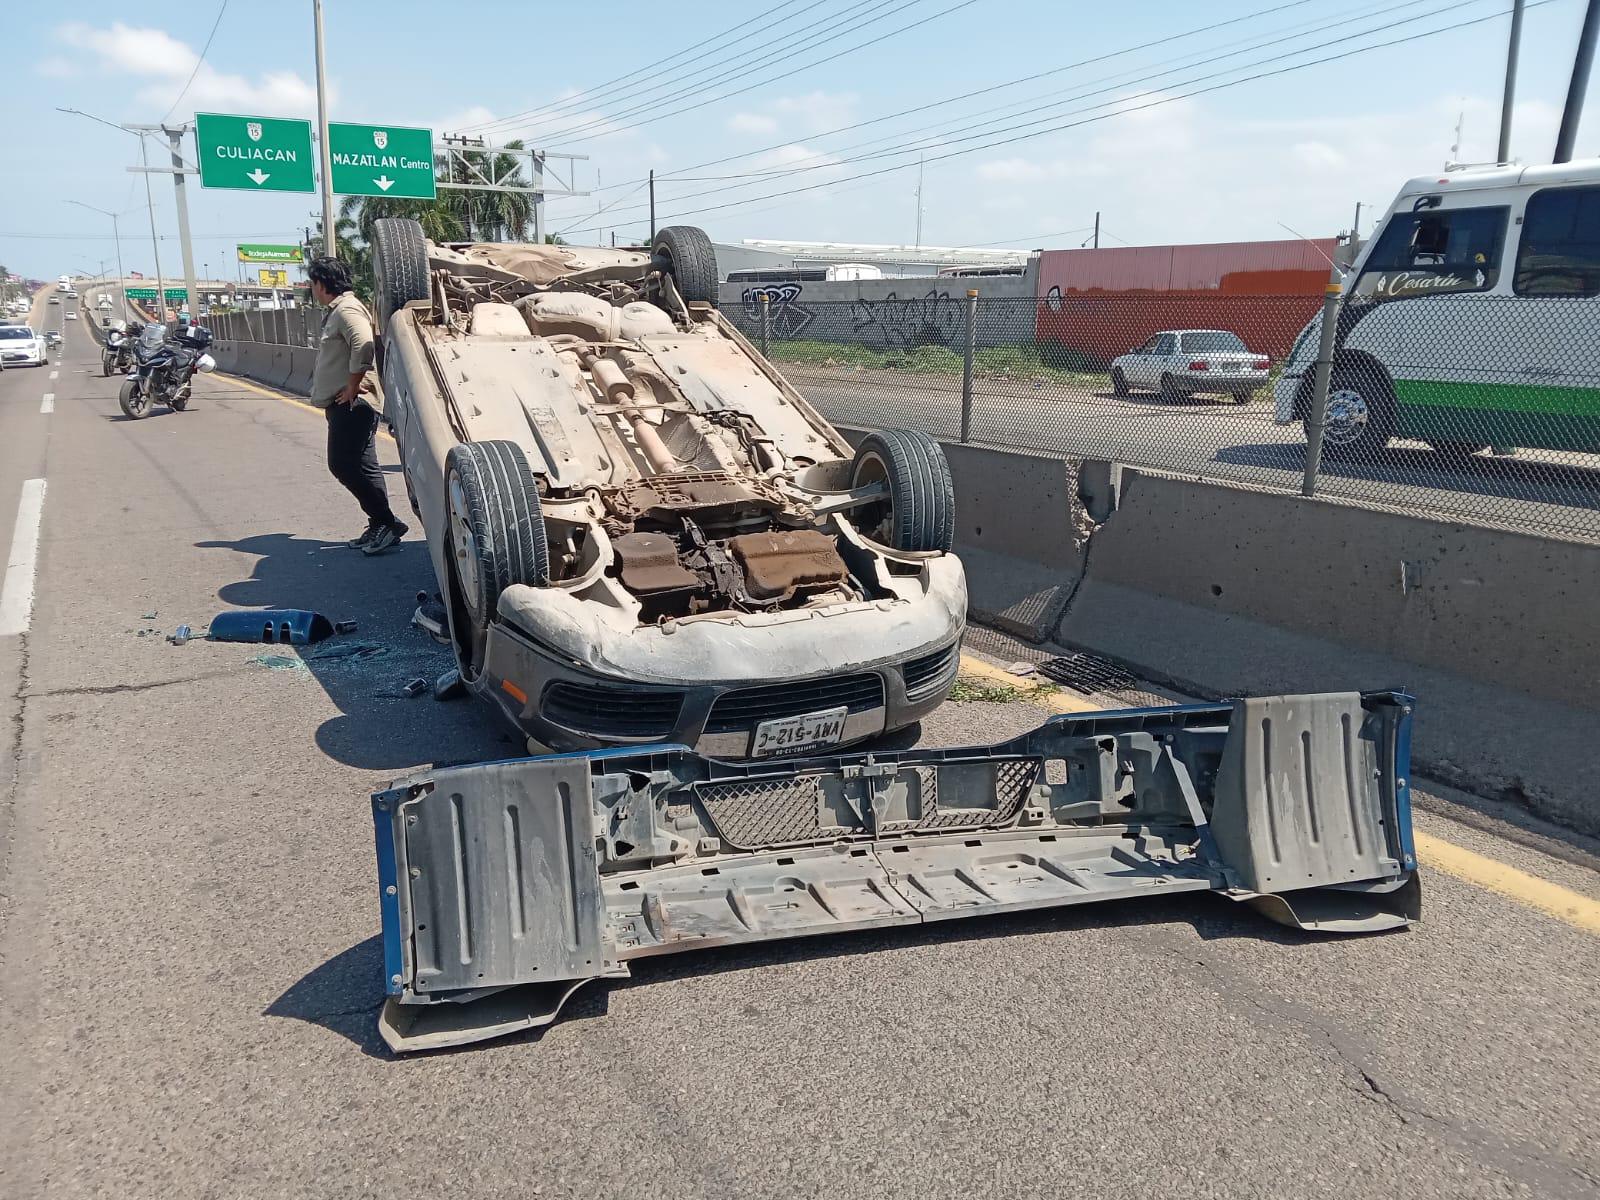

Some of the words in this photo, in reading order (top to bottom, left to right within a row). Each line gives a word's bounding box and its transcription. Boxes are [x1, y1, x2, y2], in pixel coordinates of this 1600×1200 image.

[216, 145, 297, 163] CULIACAN
[333, 152, 398, 169] MAZATLAN
[400, 156, 430, 171] Centro
